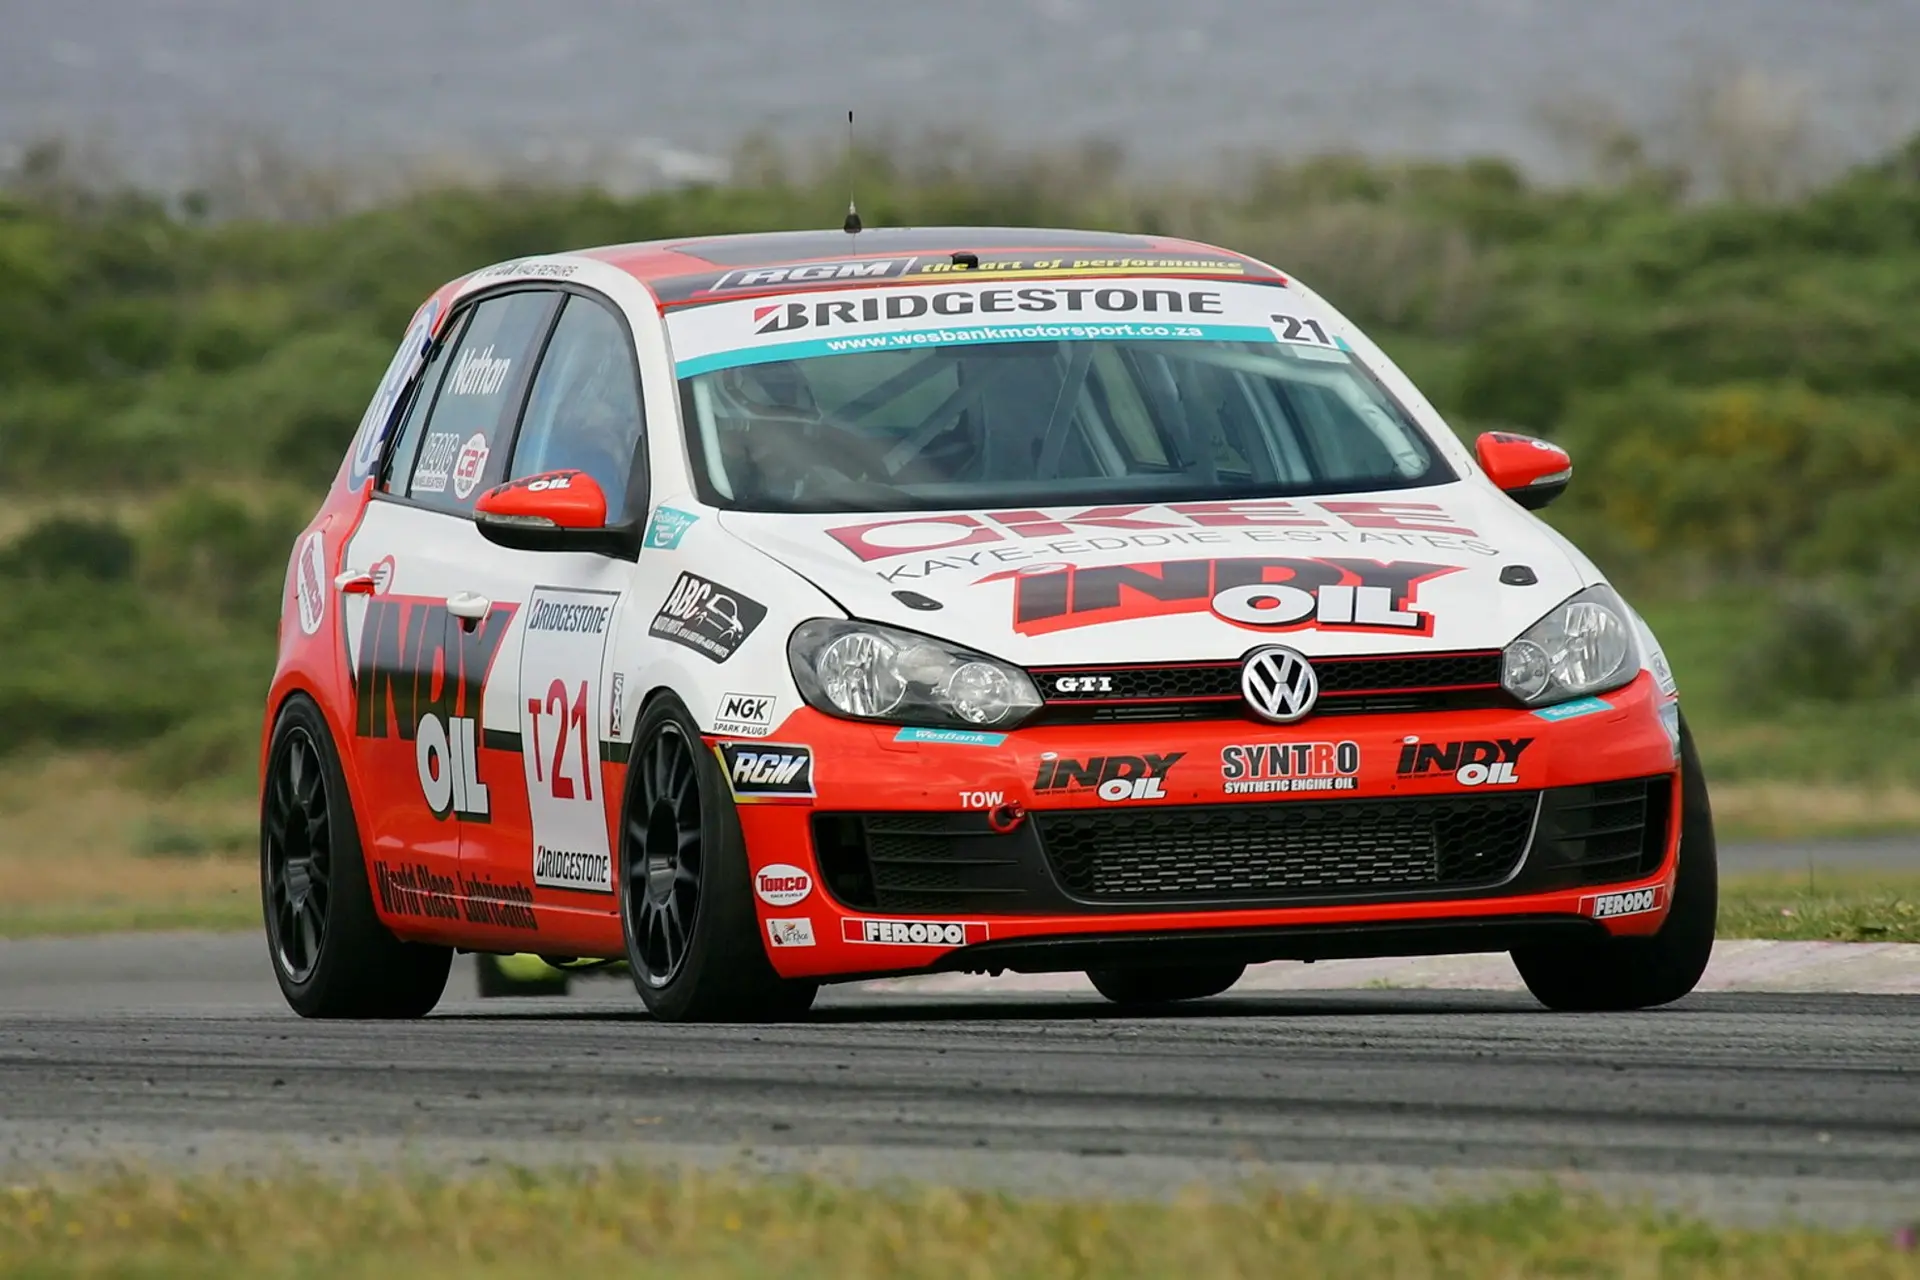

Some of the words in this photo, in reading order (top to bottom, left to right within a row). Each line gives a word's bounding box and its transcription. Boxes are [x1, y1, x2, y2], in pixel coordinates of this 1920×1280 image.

[921, 262, 968, 273] the
[1034, 259, 1062, 269] of
[1073, 257, 1242, 269] performance
[754, 288, 1224, 335] BRIDGESTONE
[826, 323, 1203, 350] www.wesbankmotorsport.co.za
[1270, 314, 1331, 345] 21
[448, 344, 511, 395] Nathan
[528, 478, 571, 492] OIL
[876, 530, 1231, 584] KAYE-EDDIE
[1242, 530, 1500, 556] ESTATES
[663, 575, 711, 620] ABC
[1211, 584, 1420, 627] OIL
[528, 599, 609, 634] BRIDGESTONE
[1055, 677, 1112, 692] GTI
[724, 697, 768, 720] NGK
[713, 723, 739, 734] SPARK
[741, 725, 768, 736] PLUGS
[915, 730, 985, 742] WesBank
[416, 713, 490, 815] OIL
[733, 752, 808, 785] RGM
[1221, 740, 1360, 780] SYNTRO
[1224, 779, 1290, 794] SYNTHETIC
[1291, 778, 1333, 792] ENGINE
[1334, 777, 1354, 789] OIL
[1456, 762, 1519, 786] OIL
[959, 791, 1004, 808] TOW
[1097, 776, 1167, 801] OIL
[536, 846, 608, 882] BRIDGESTONE
[1595, 890, 1653, 917] FERODO
[865, 921, 964, 945] FERODO
